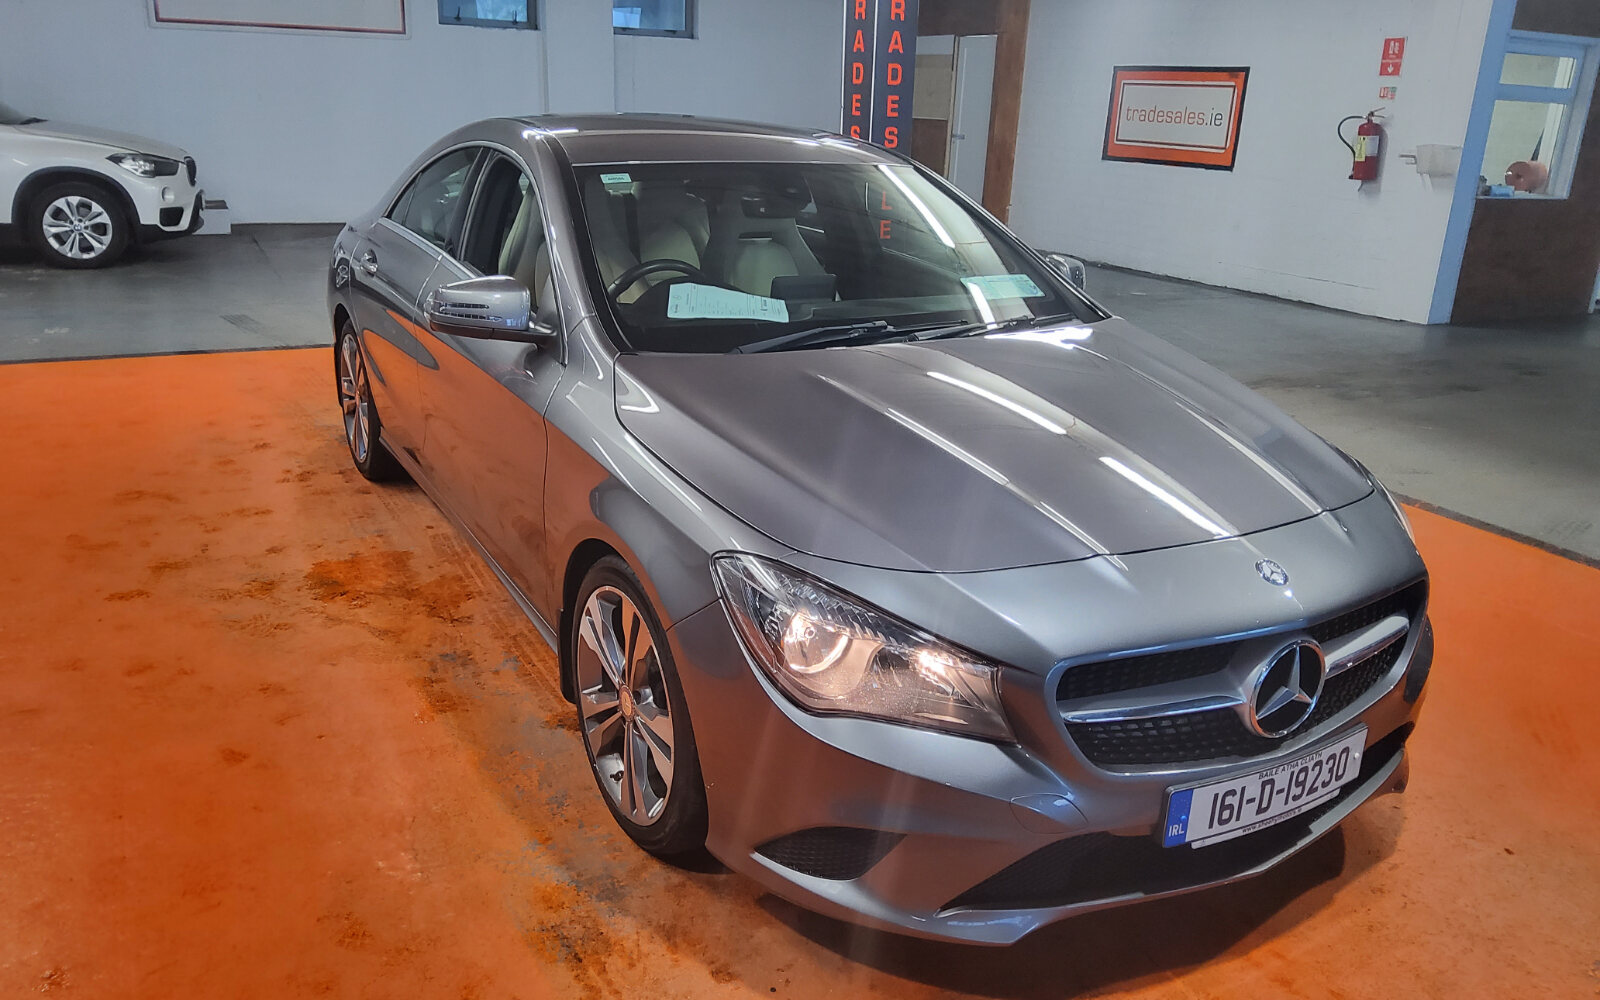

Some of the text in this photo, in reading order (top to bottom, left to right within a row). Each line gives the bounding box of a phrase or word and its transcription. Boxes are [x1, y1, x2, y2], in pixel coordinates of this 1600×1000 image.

[1126, 105, 1223, 127] tradesales.ie
[1258, 768, 1279, 780] BAILE
[1300, 752, 1323, 766] CLIATH
[1208, 746, 1350, 829] 161-D-19230
[1168, 824, 1185, 837] IRL
